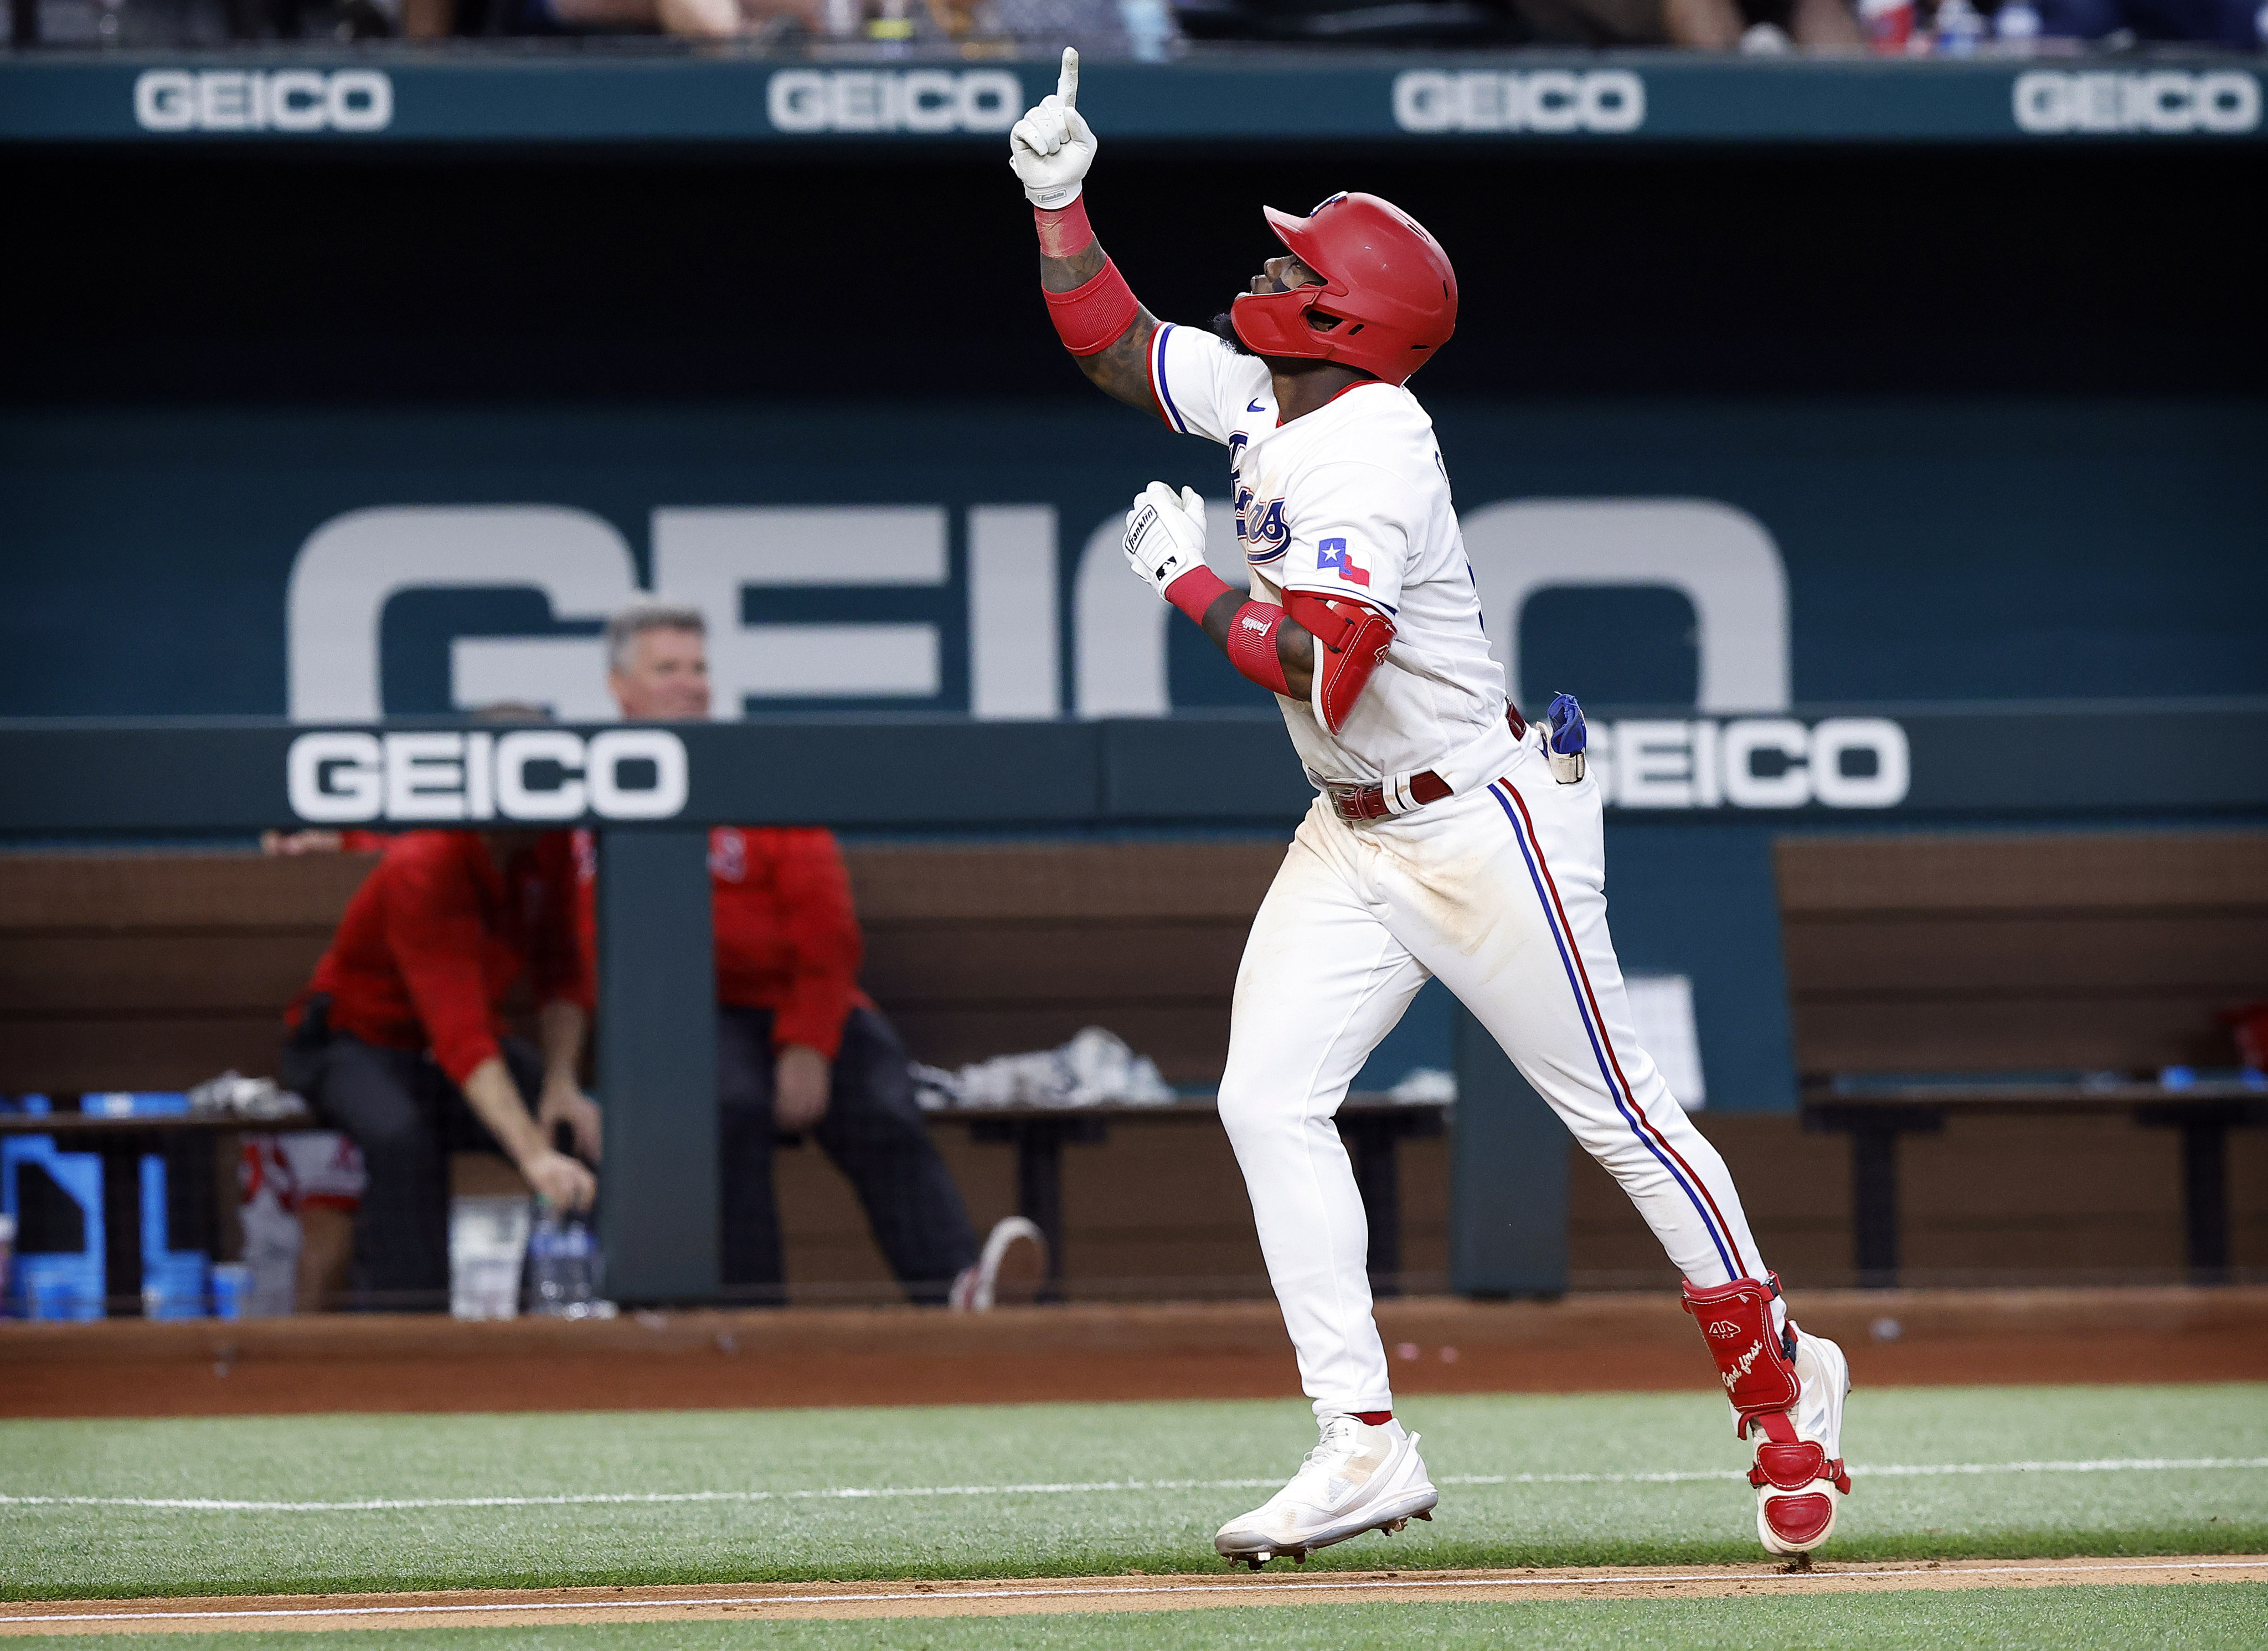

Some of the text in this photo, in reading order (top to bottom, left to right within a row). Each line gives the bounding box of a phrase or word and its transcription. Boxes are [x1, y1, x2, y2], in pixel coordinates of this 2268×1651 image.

[135, 69, 393, 131] GEICO
[767, 69, 1022, 132] GEICO
[1394, 70, 1645, 132] GEICO
[2013, 70, 2260, 132] GEICO
[287, 503, 1793, 719] GEIO
[287, 729, 688, 822] GEICO
